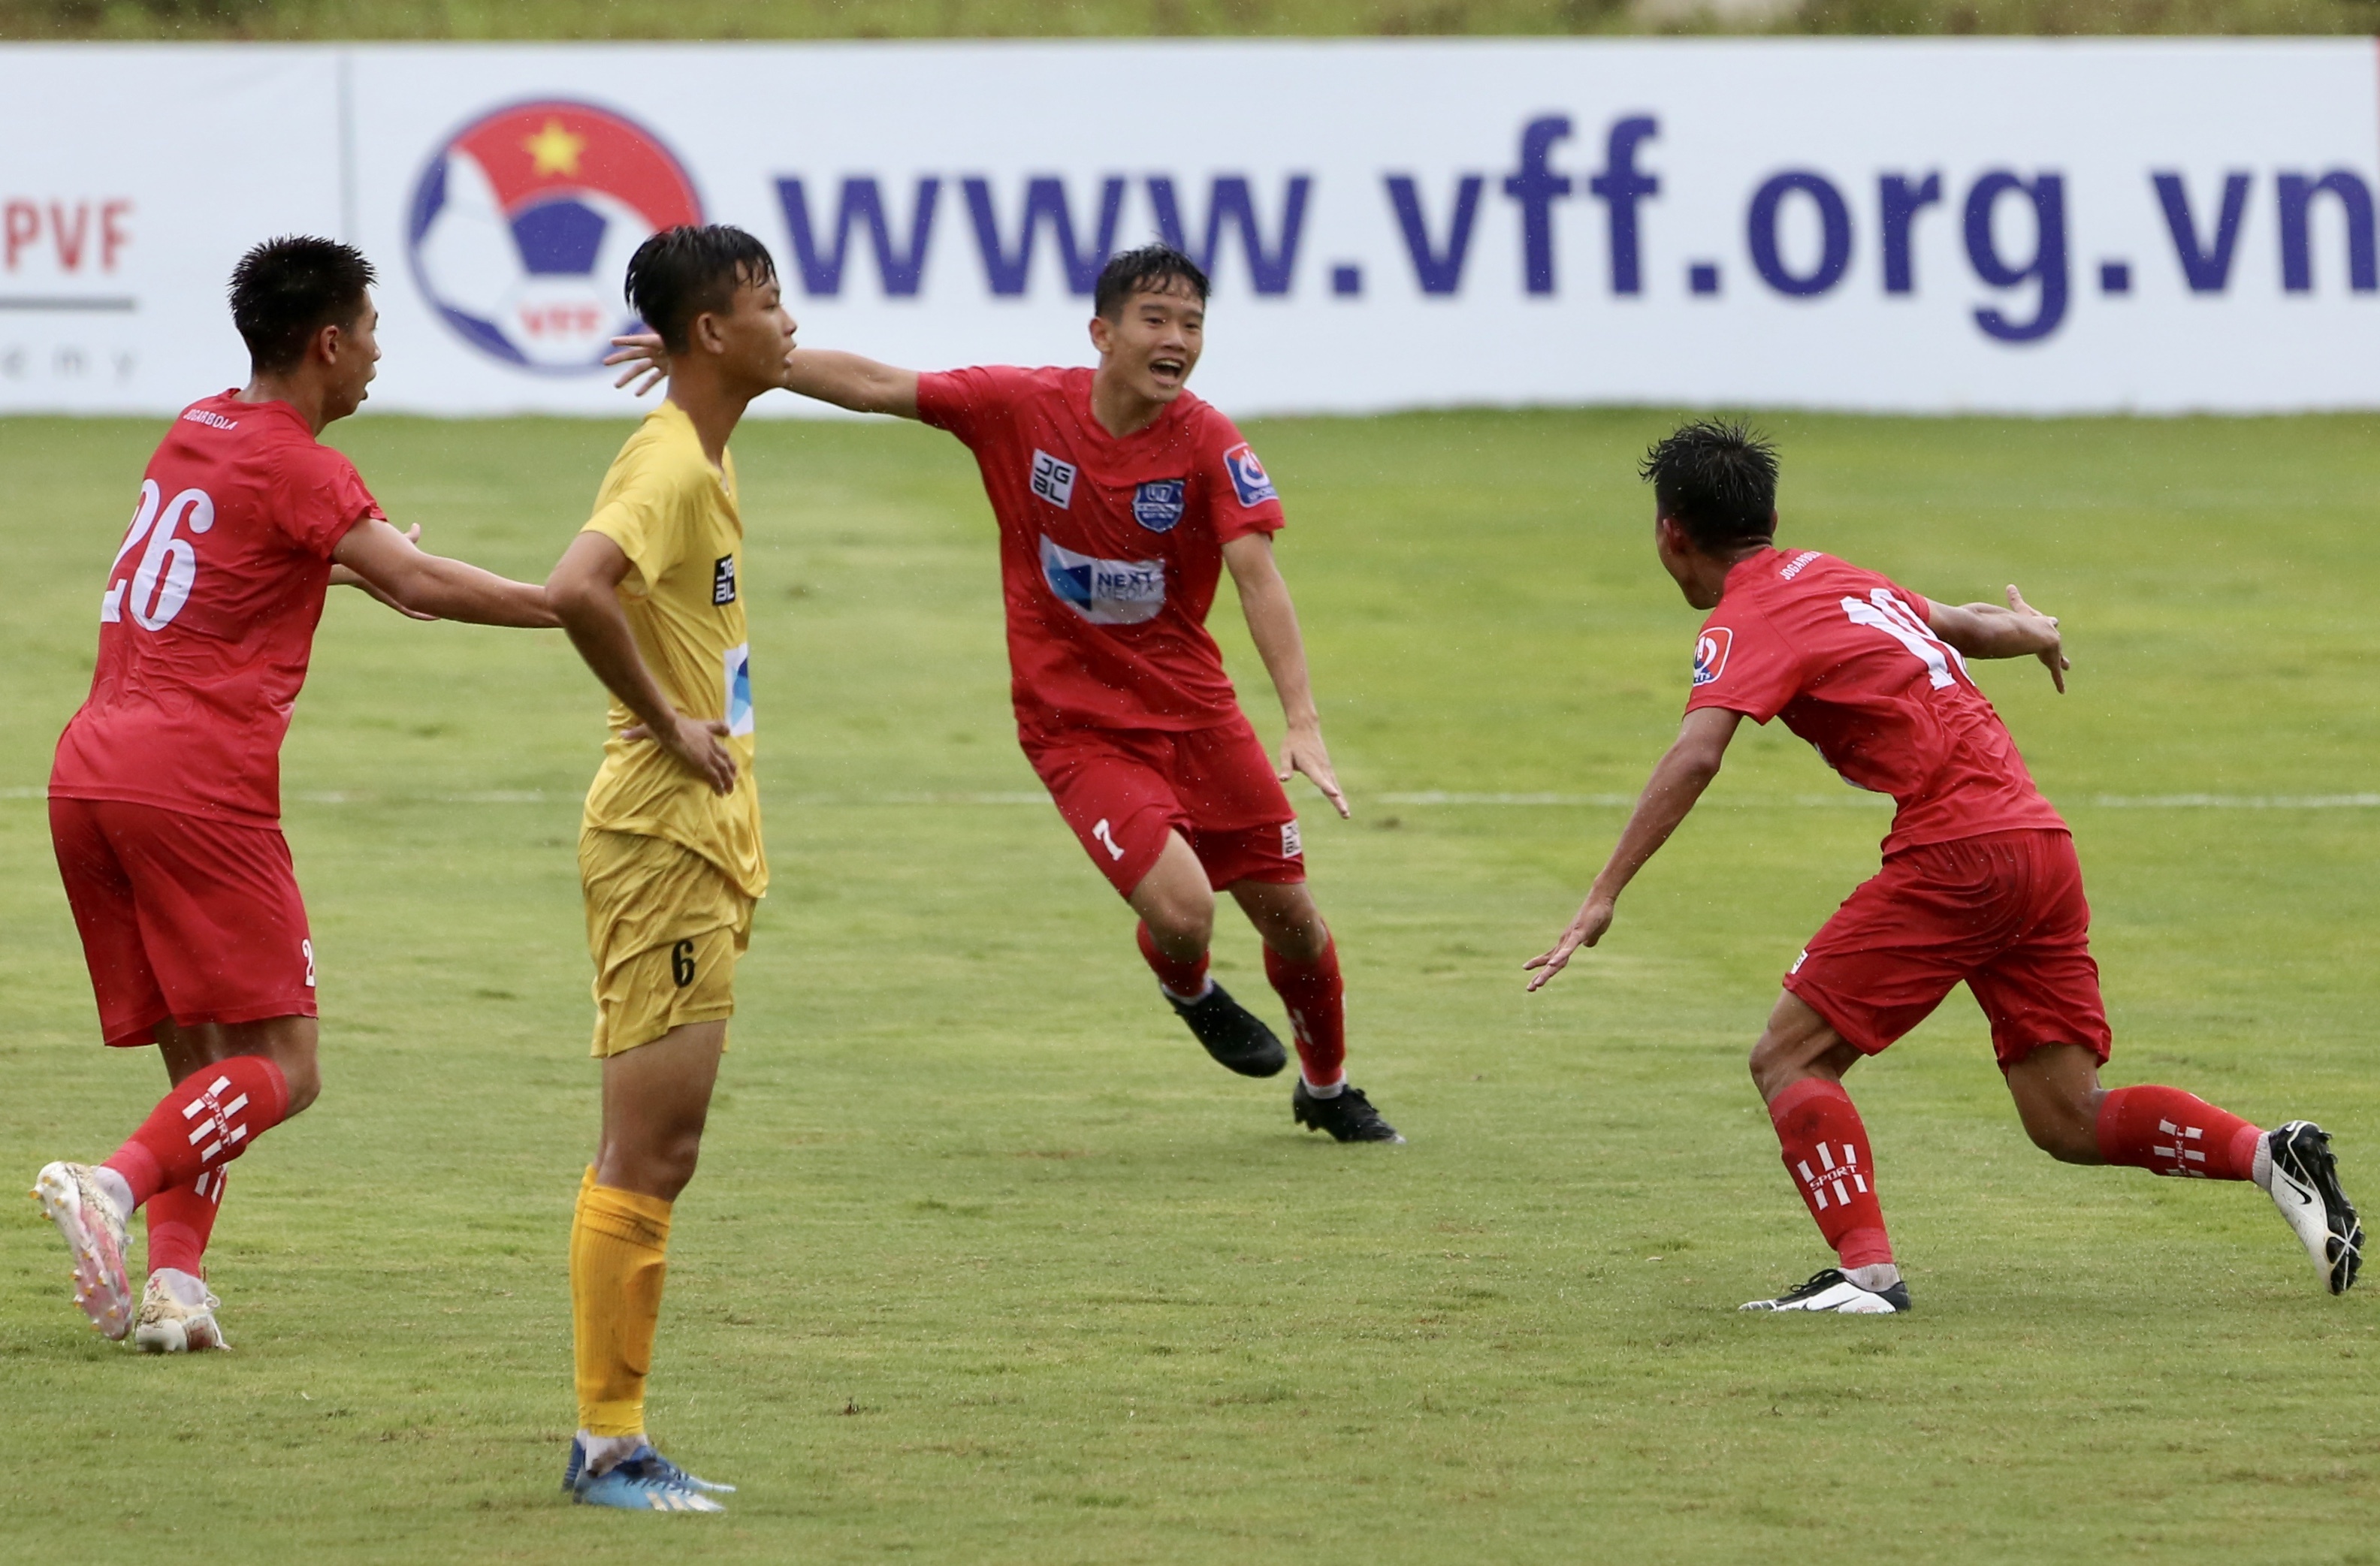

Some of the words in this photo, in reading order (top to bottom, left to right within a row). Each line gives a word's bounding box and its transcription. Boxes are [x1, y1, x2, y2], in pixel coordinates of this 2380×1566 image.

[4, 198, 134, 273] PVF
[772, 113, 2380, 344] www.vff.org.vn
[101, 478, 215, 632] 26
[1098, 572, 1152, 587] NEXT
[1092, 818, 1125, 861] 7
[671, 940, 696, 988] 6
[201, 1092, 231, 1147] SPORT
[1809, 1165, 1857, 1190] SPORT
